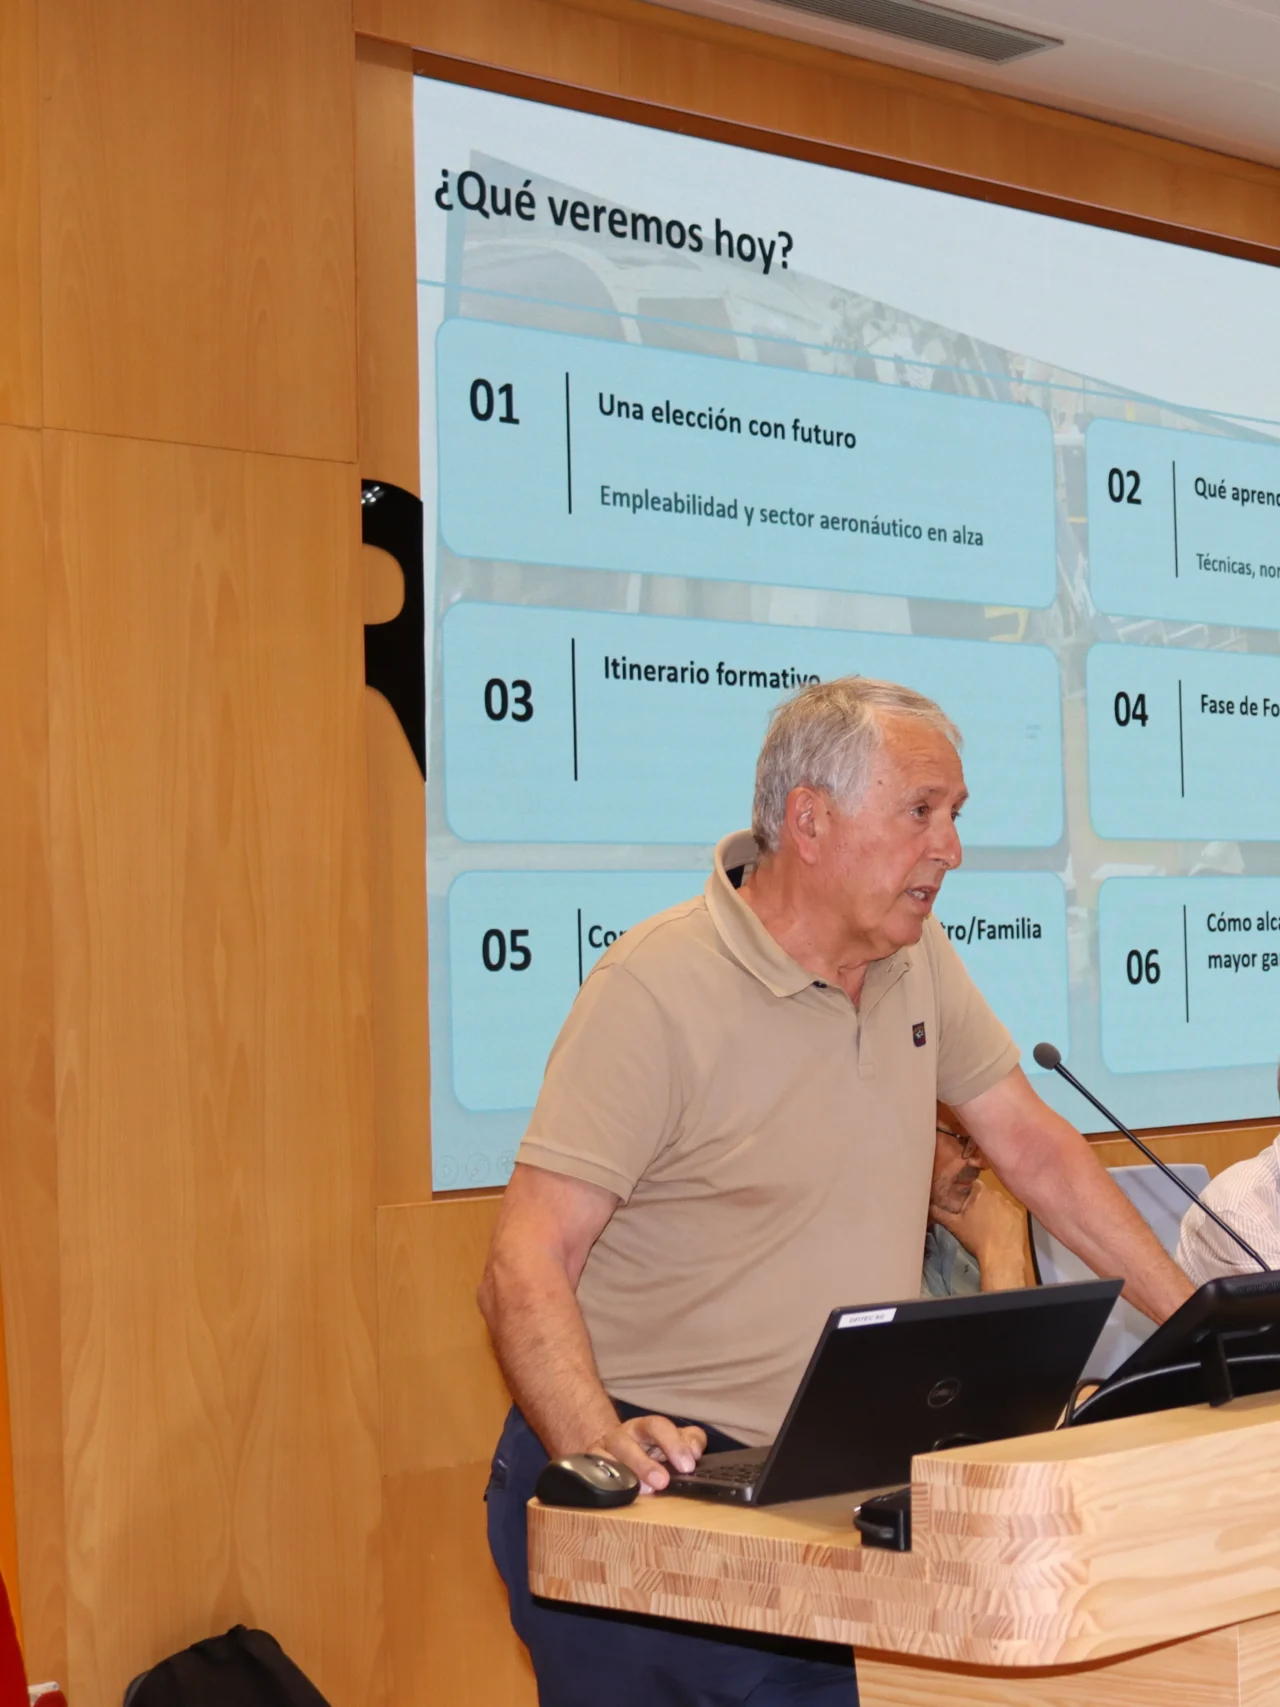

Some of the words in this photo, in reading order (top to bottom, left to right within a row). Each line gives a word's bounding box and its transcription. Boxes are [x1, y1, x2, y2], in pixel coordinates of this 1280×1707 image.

[434, 168, 536, 222] ¿Qué
[548, 194, 703, 253] veremos
[714, 217, 794, 275] hoy?
[469, 377, 521, 426] 01
[598, 391, 645, 421] Una
[650, 399, 742, 435] elección
[748, 418, 786, 441] con
[791, 417, 857, 450] futuro
[1107, 467, 1143, 506] 02
[1193, 476, 1227, 501] Qué
[600, 484, 738, 520] Empleabilidad
[743, 505, 755, 527] y
[759, 507, 815, 528] sector
[819, 513, 923, 541] aeronáutico
[927, 525, 948, 543] en
[952, 524, 984, 547] alza
[1195, 552, 1256, 579] Técnicas,
[603, 655, 710, 685] Itinerario
[483, 677, 534, 723] 03
[1113, 691, 1149, 728] 04
[1200, 693, 1235, 716] Fase
[1239, 694, 1259, 718] de
[587, 924, 627, 949] Co
[1206, 911, 1253, 933] Cómo
[481, 928, 532, 973] 05
[1126, 948, 1161, 986] 06
[1207, 952, 1258, 974] mayor
